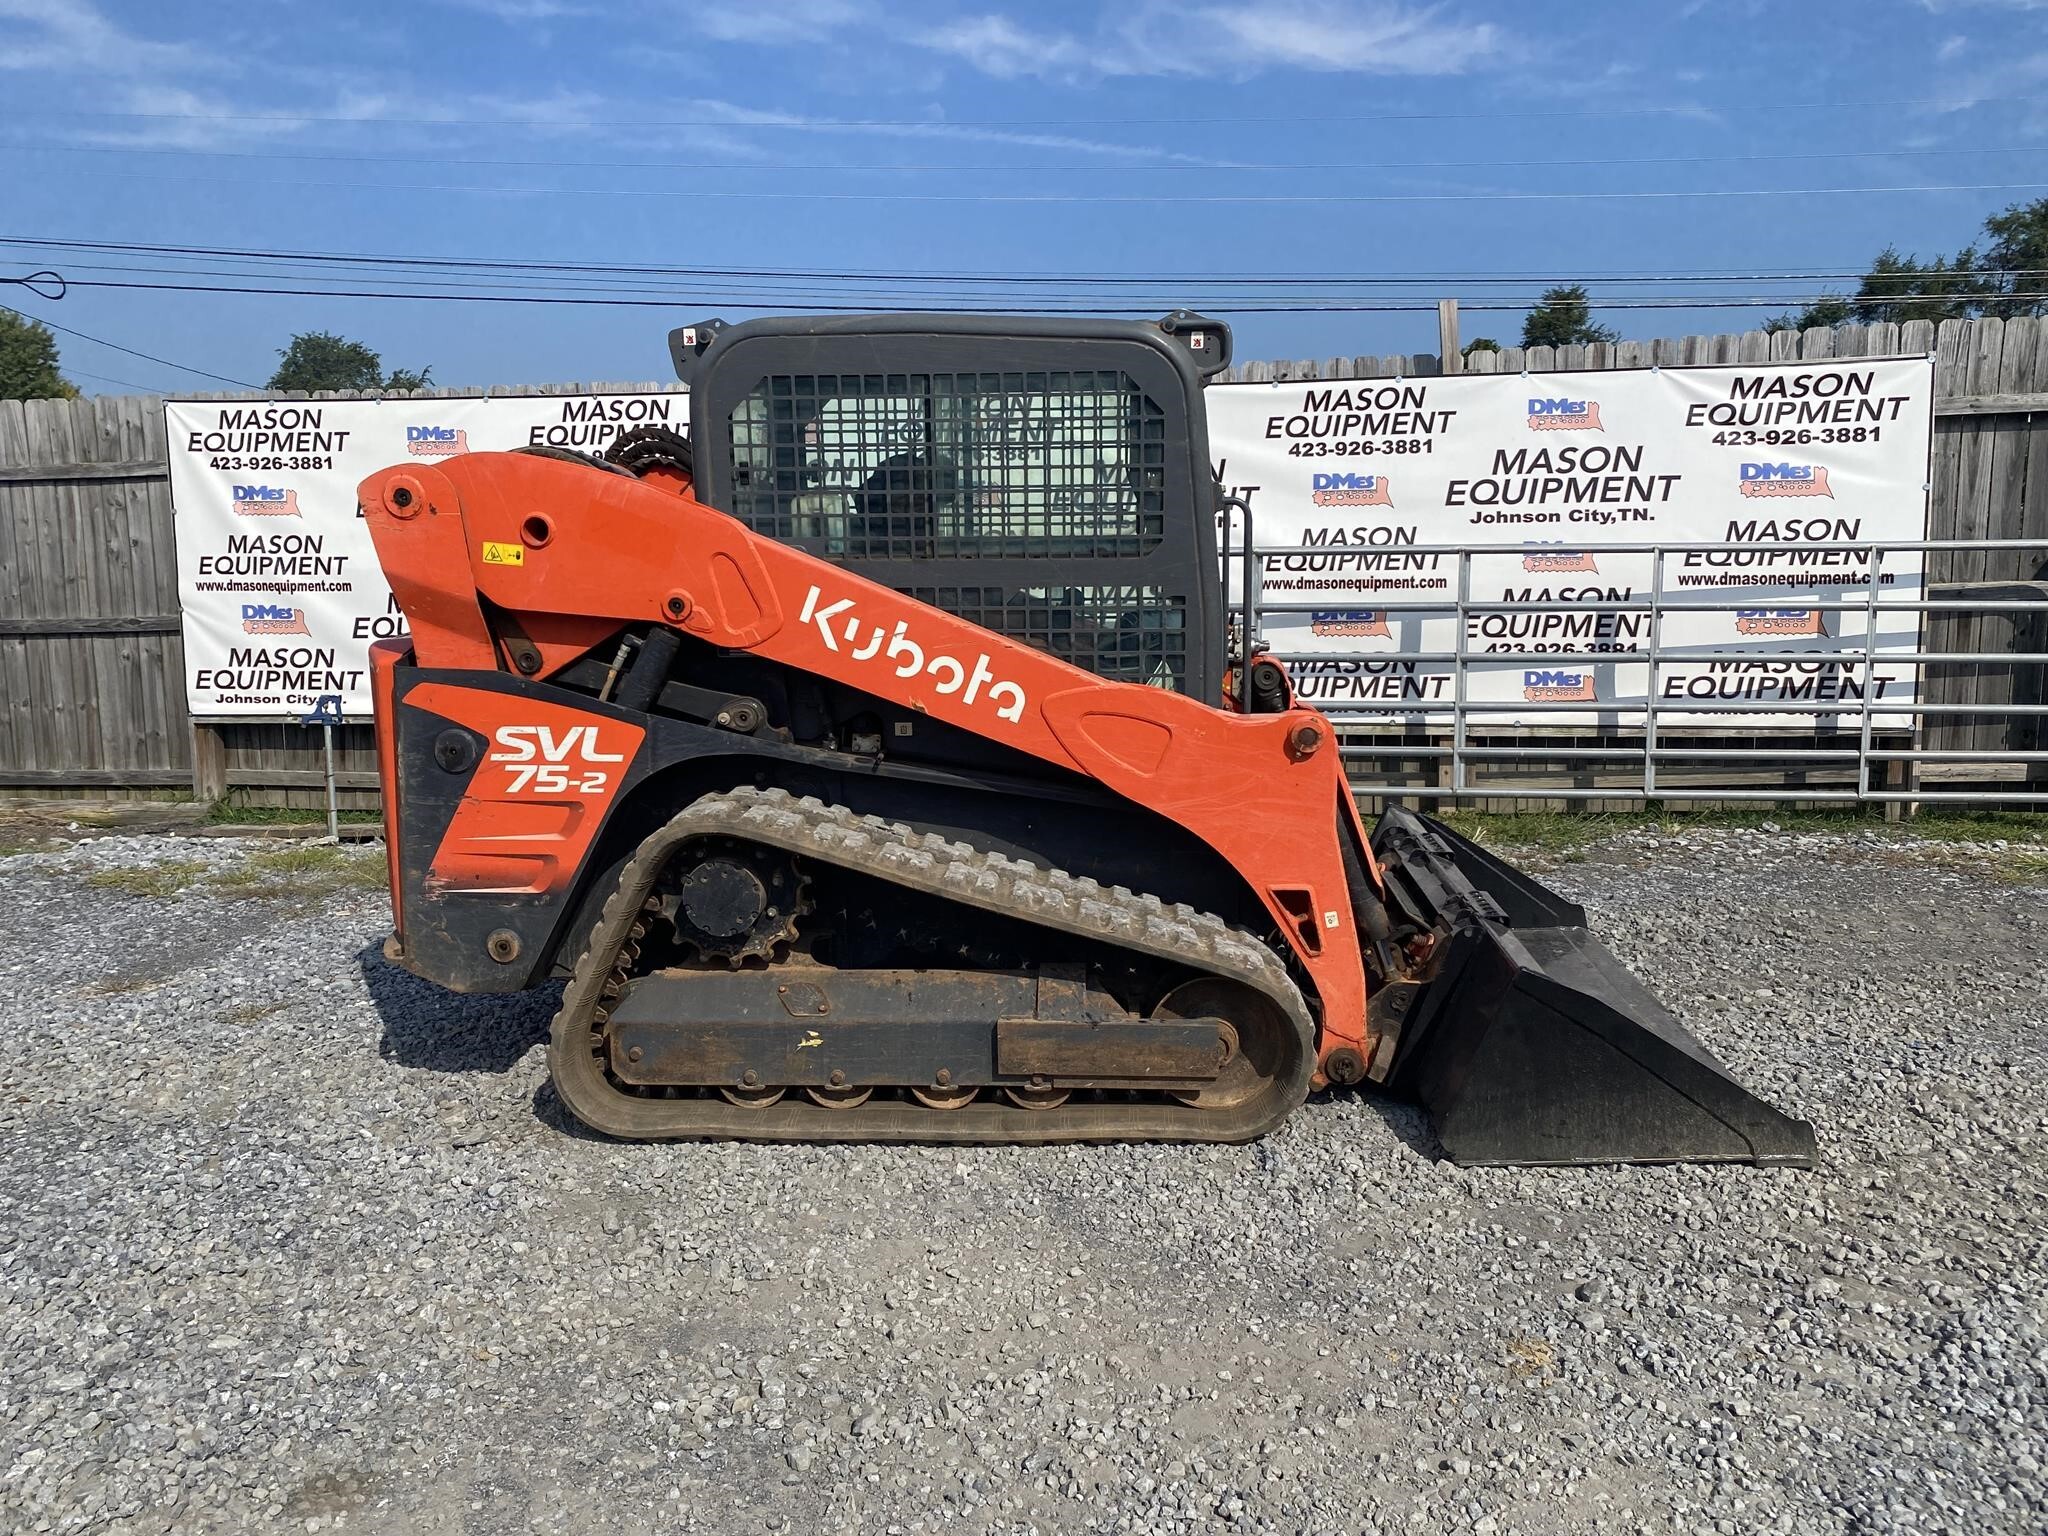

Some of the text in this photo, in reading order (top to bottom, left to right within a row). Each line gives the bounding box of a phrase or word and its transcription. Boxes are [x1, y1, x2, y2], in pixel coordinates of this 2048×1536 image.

[1730, 372, 1875, 400] MASON
[1303, 386, 1426, 412] MASON
[219, 409, 322, 430] MASON
[562, 399, 670, 422] MASON
[1685, 397, 1910, 426] EQUIPMENT
[1265, 411, 1458, 438] EQUIPMENT
[188, 432, 350, 453] EQUIPMENT
[1712, 426, 1881, 446] 423-926-3881
[1288, 439, 1433, 457] 423-926-3881
[210, 456, 333, 470] 423-926-3881
[1492, 446, 1643, 475] MASON
[1445, 475, 1681, 506] EQUIPMENT
[1470, 508, 1655, 524] Johnson City,TN.
[1302, 527, 1417, 546] MASON
[1725, 519, 1861, 541] MASON
[227, 535, 323, 554] MASON
[199, 556, 348, 576] EQUIPMENT
[196, 579, 352, 595] www.dmasonequipment.com
[1262, 576, 1447, 592] www.dmasonequipment.com
[1678, 571, 1895, 588] www.dmasonequipment.cm
[228, 648, 335, 668] MASON
[799, 585, 1026, 724] Kubota
[195, 670, 363, 690] EQUIPMENT
[1663, 676, 1896, 699] EQUIPMENT
[215, 694, 280, 704] Johnson
[490, 726, 624, 762] SVL
[504, 765, 607, 793] 75-2
